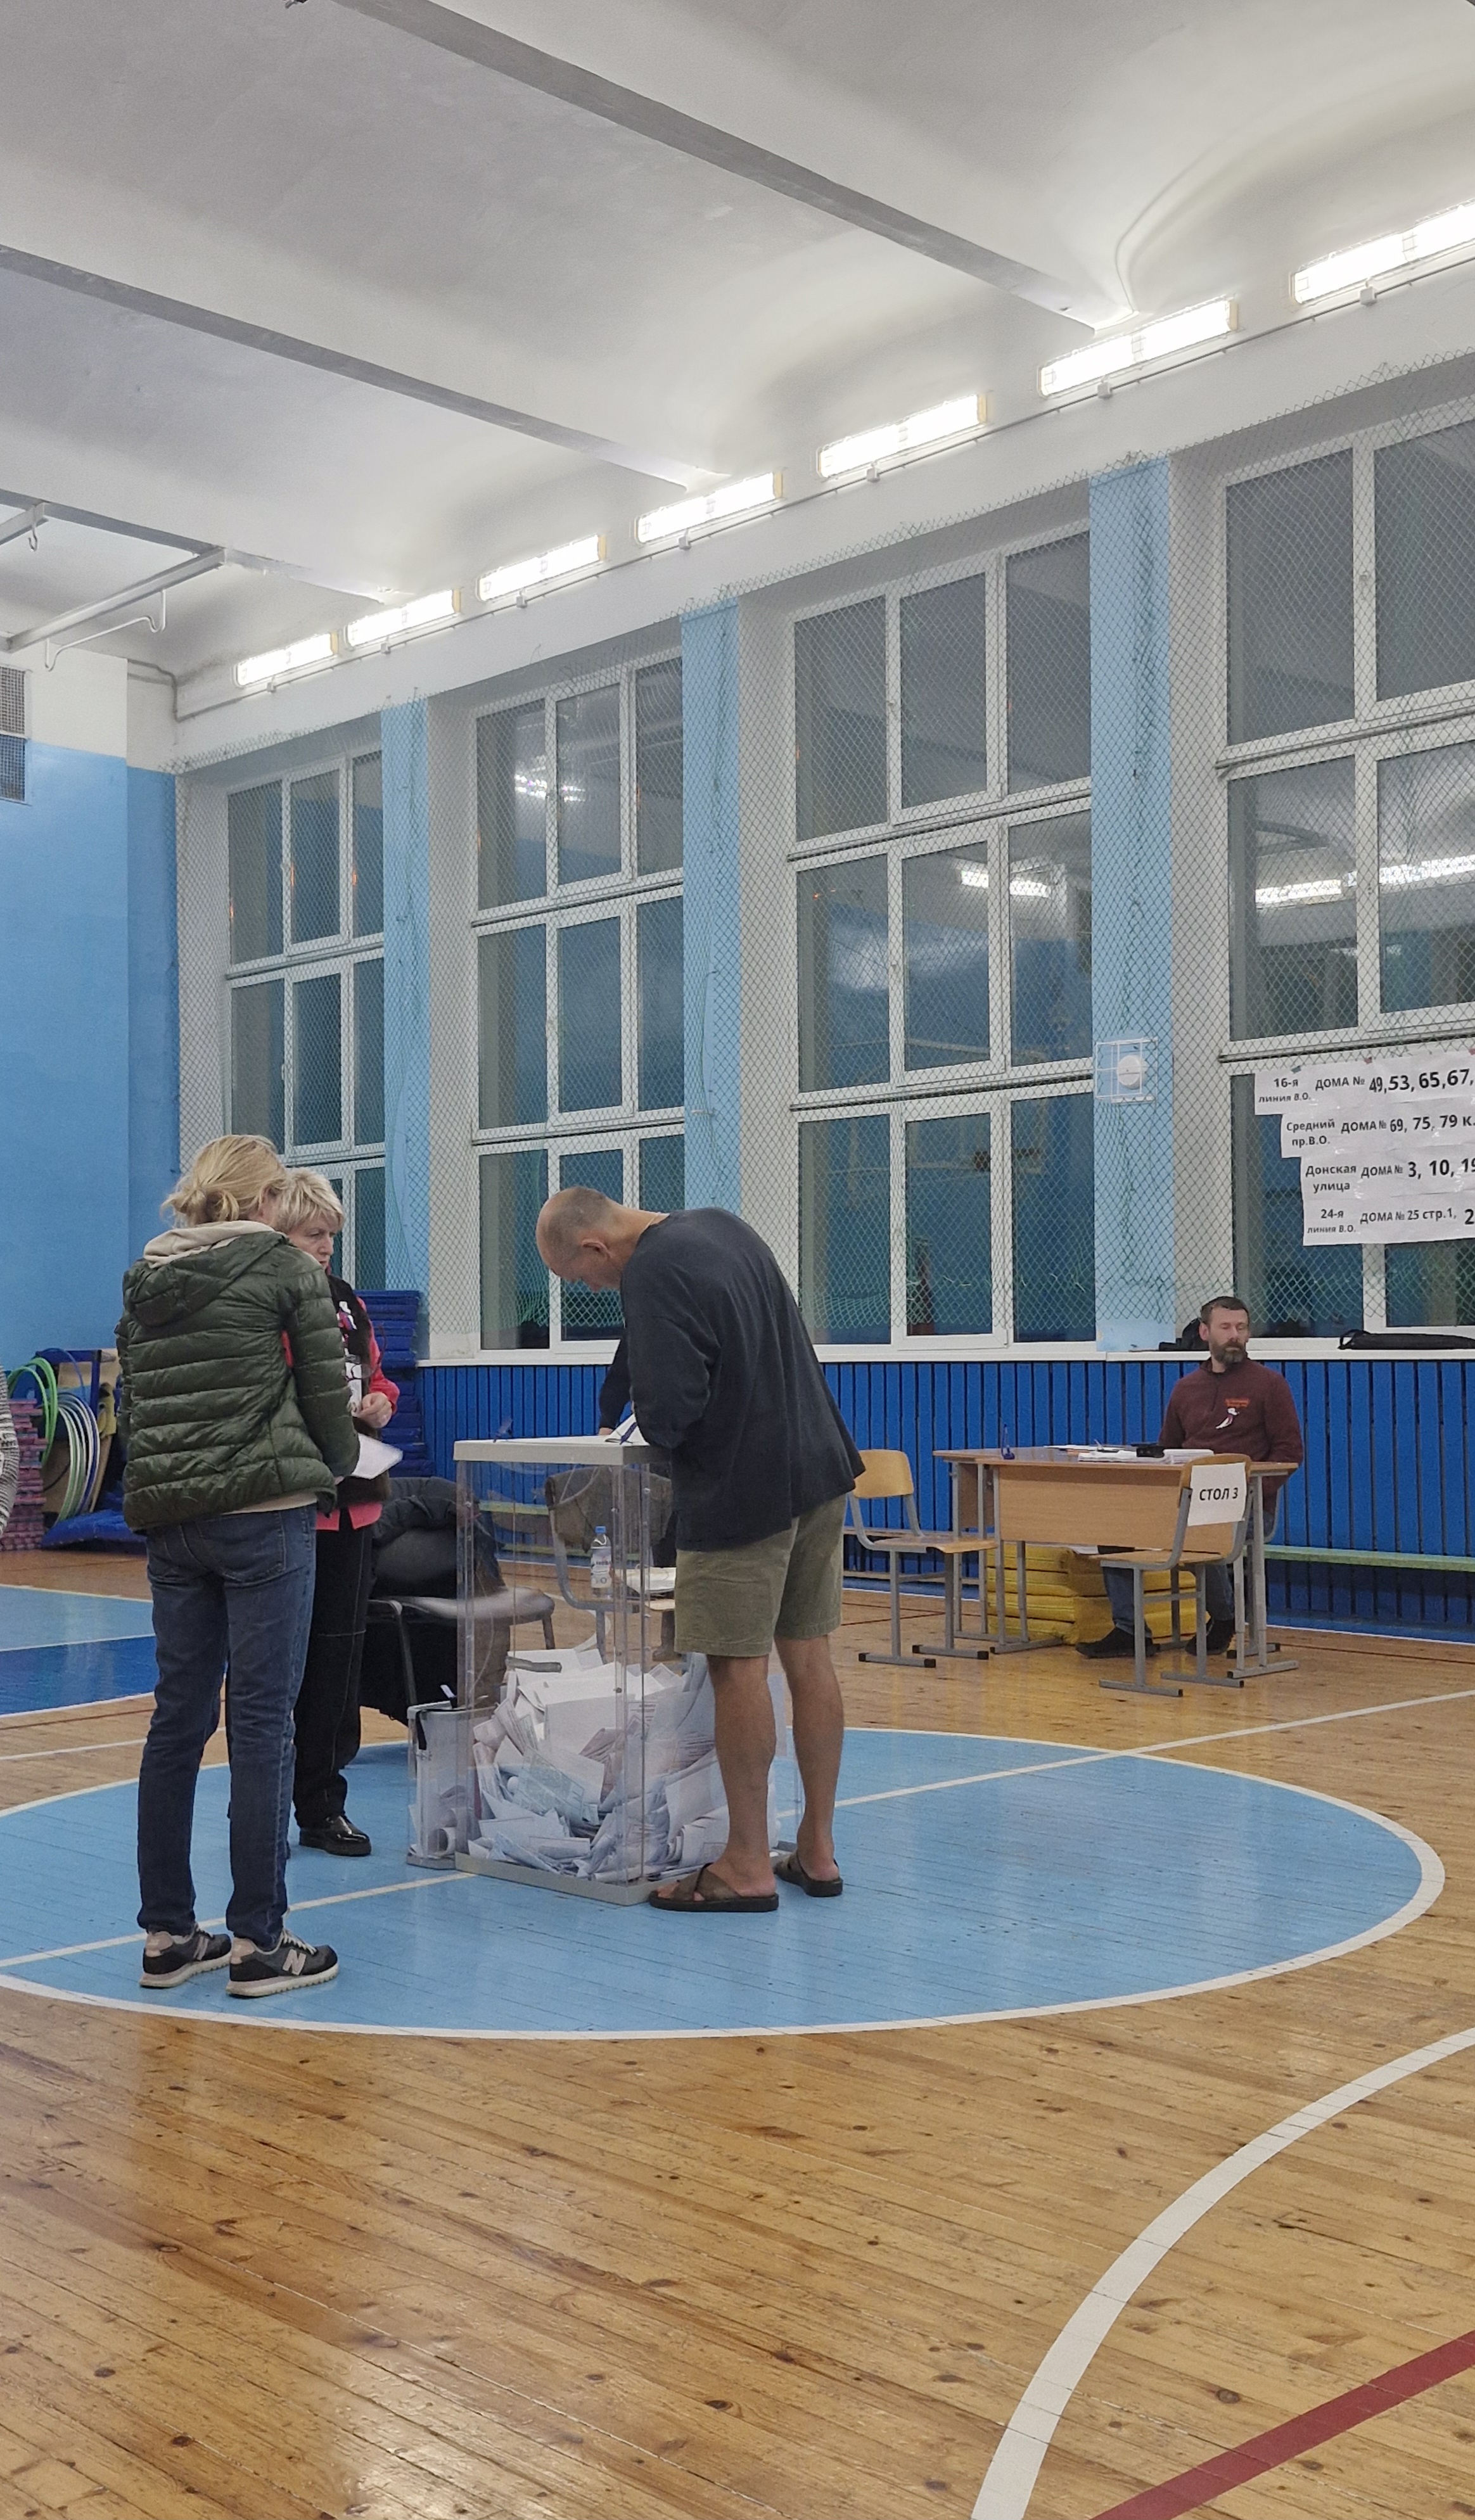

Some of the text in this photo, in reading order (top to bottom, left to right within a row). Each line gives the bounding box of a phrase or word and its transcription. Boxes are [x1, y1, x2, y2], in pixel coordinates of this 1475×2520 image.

[1274, 1078, 1298, 1088] 16-я
[1315, 1077, 1350, 1091] ДОМА
[1353, 1076, 1365, 1085] №
[1286, 1119, 1335, 1133] Средний
[1341, 1121, 1377, 1134] ДОМА
[1390, 1118, 1407, 1133] 69,
[1440, 1114, 1458, 1128] 79
[1305, 1165, 1357, 1178] Донская
[1360, 1165, 1393, 1179] ДОМА
[1408, 1161, 1422, 1180] 3,
[1429, 1159, 1455, 1178] 10,
[1313, 1182, 1350, 1194] улица
[1320, 1209, 1344, 1219] 24-я
[1360, 1212, 1393, 1225] ДОМА
[1407, 1209, 1419, 1221] 25
[1199, 1487, 1239, 1501] СТОЛ 3
[282, 1948, 307, 1976] N
